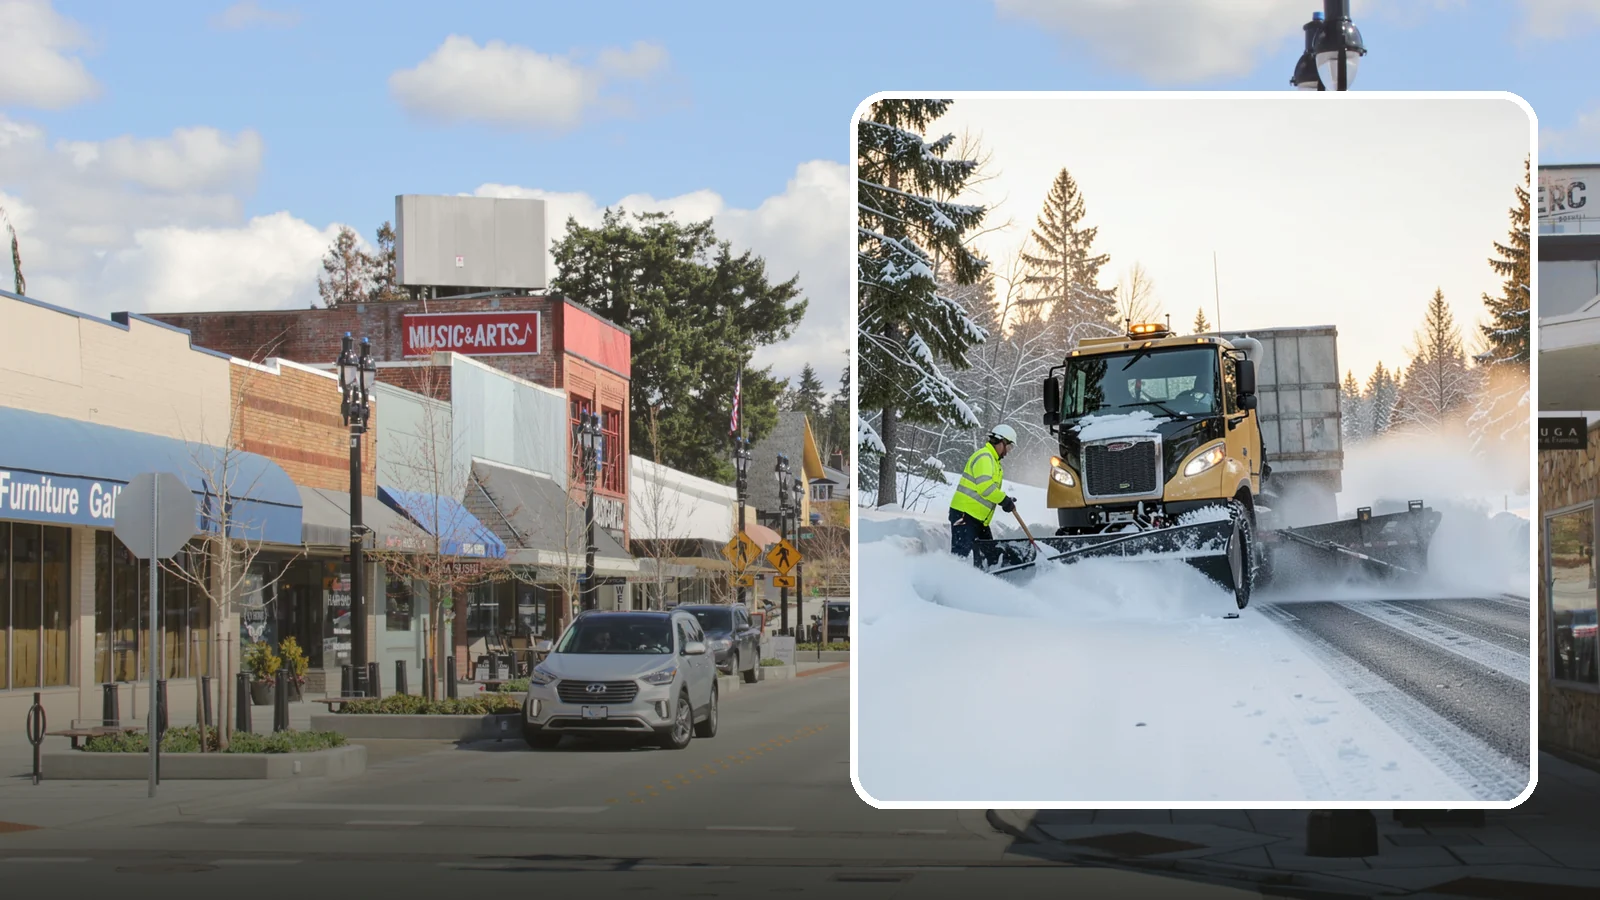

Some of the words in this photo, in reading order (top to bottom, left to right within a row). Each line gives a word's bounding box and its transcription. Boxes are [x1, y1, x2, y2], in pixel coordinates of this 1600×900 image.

[409, 323, 519, 349] MUSIC&ARTS
[0, 471, 79, 515] Furniture
[89, 483, 121, 519] Gal
[453, 563, 480, 574] SUSHI
